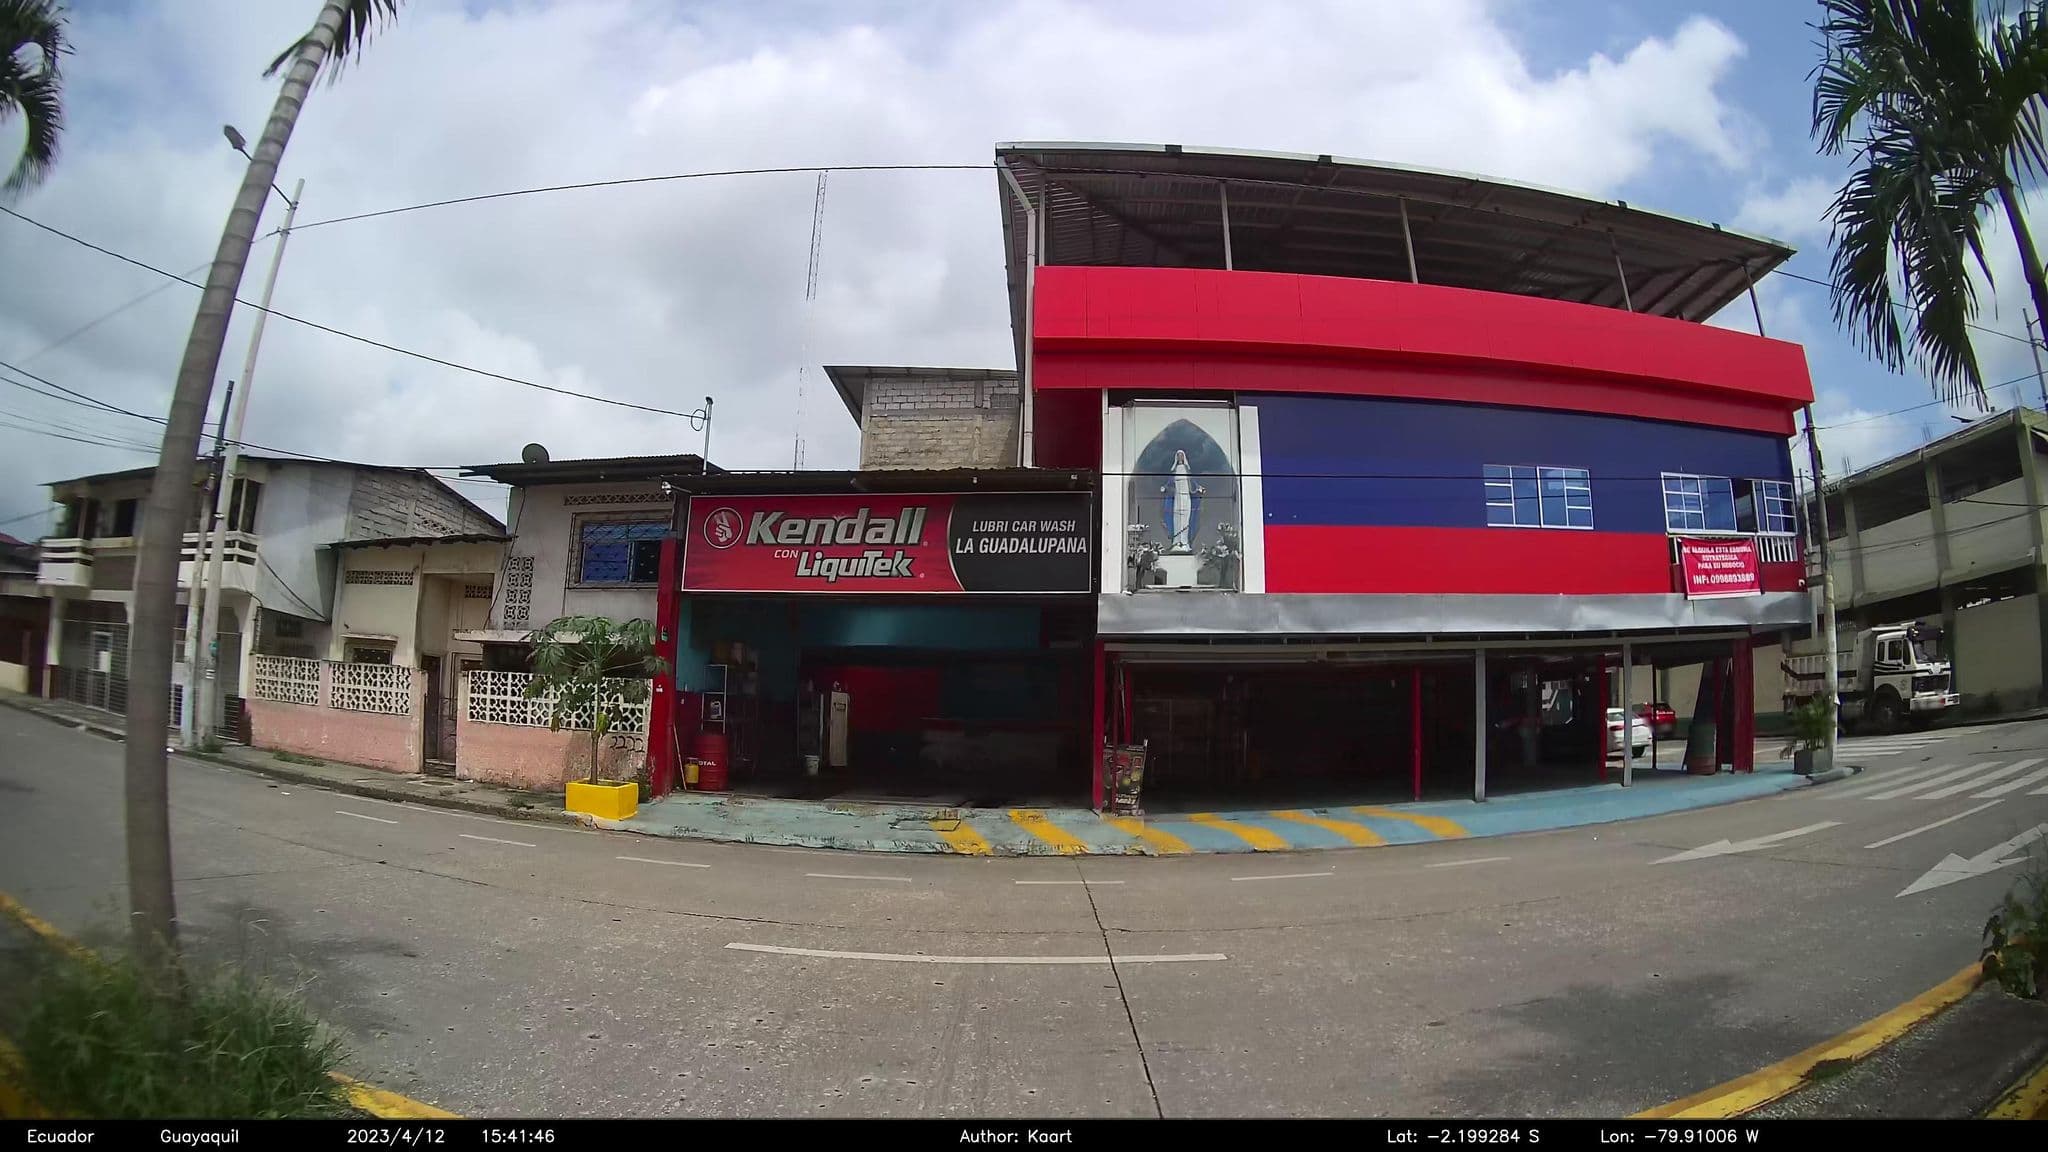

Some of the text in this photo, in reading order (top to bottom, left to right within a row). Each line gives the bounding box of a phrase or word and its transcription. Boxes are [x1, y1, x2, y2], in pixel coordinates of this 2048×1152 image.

[746, 507, 928, 546] Kendall
[972, 520, 1076, 532] LUBRI CAR WASH
[955, 536, 1087, 554] LA GUADALUPANA
[774, 549, 914, 582] CON LiquiTek
